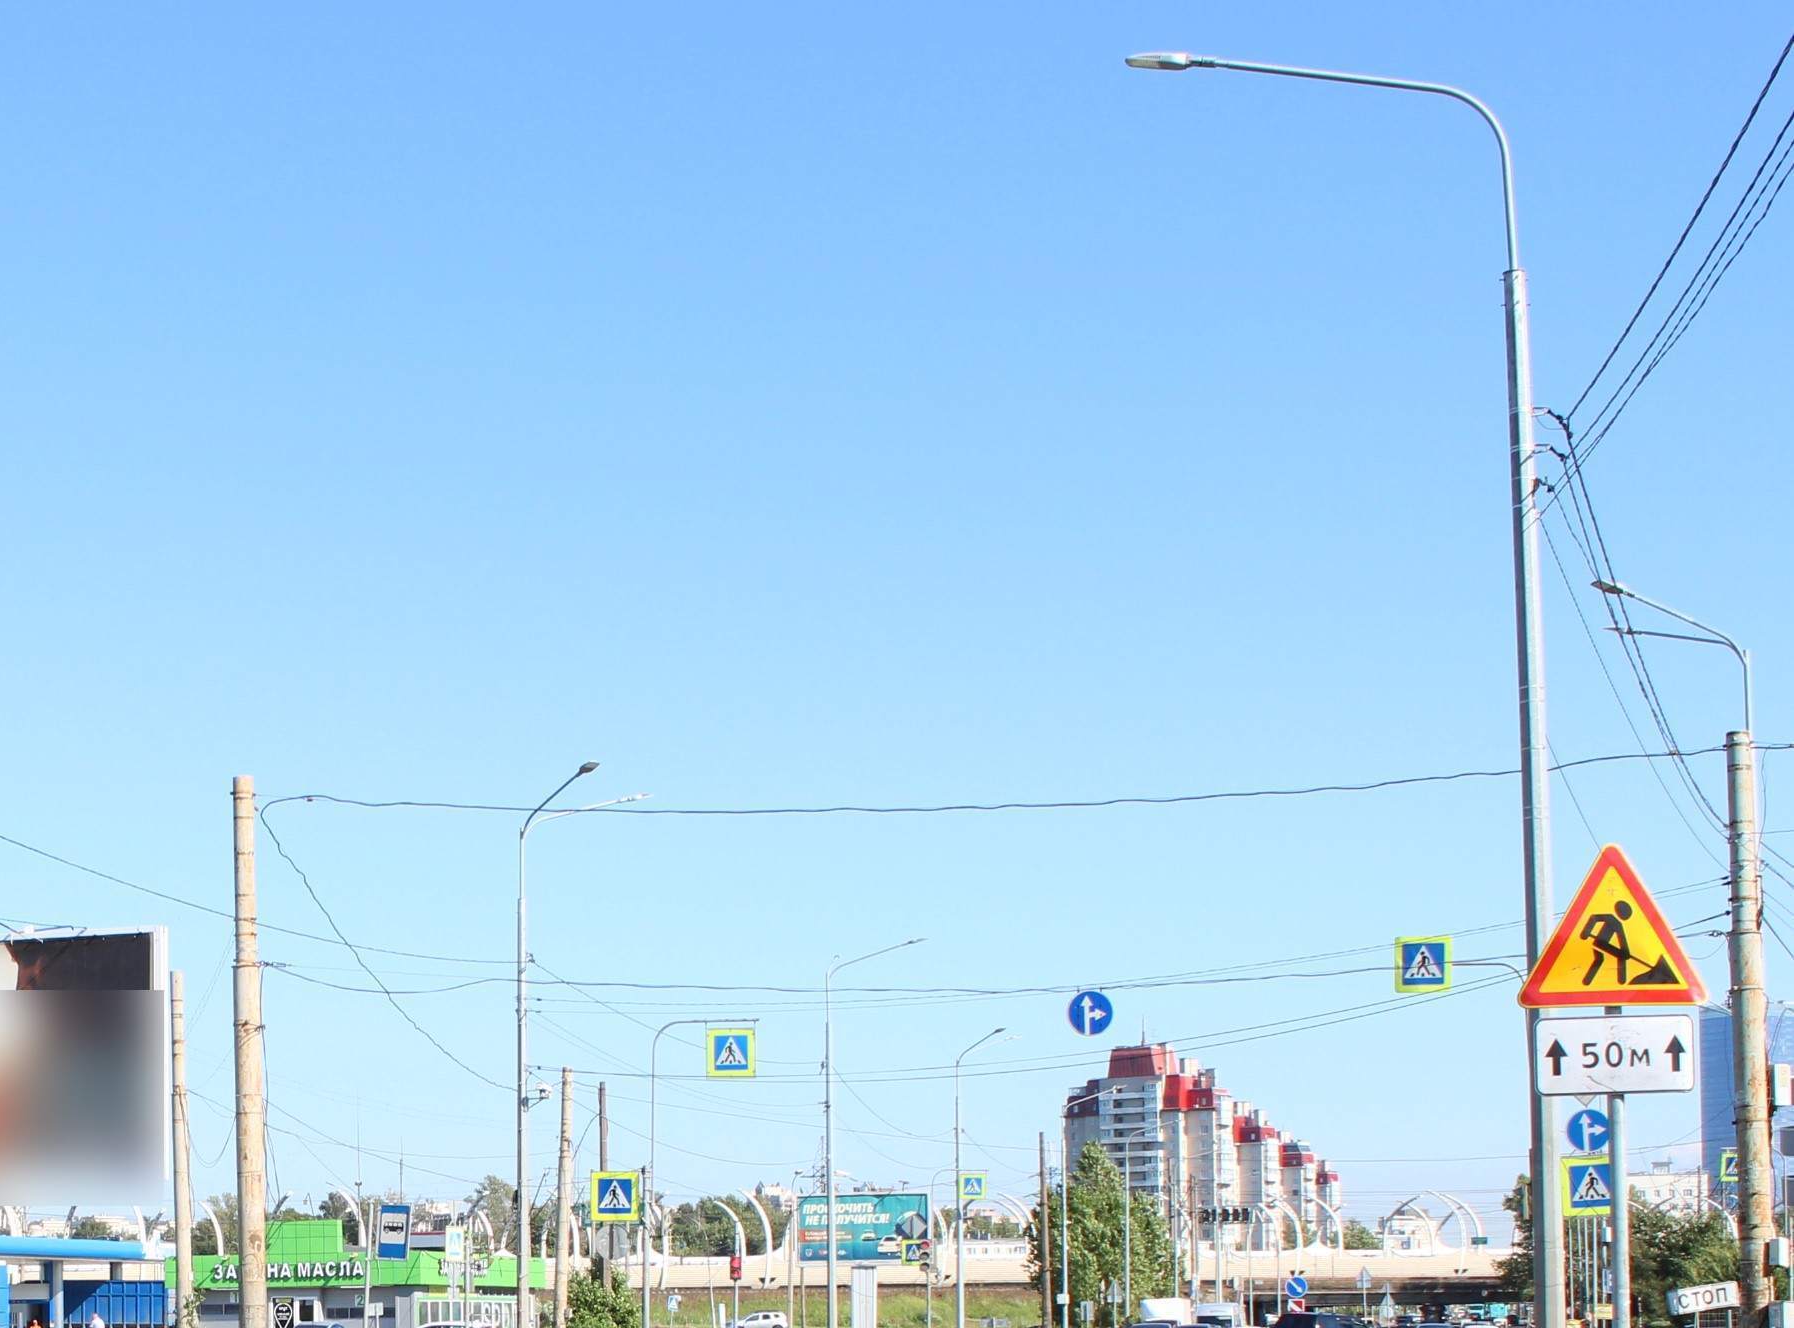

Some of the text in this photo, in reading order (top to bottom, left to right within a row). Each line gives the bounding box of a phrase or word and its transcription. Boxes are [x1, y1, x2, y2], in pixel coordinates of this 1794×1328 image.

[803, 1203, 874, 1214] ПРООЧИТЬ
[805, 1213, 890, 1225] НЕ ПЛУЧИТСЯ!
[214, 1262, 364, 1279] ЗАНА МАСЛА
[356, 1294, 365, 1306] 2
[1678, 1287, 1728, 1309] СТОП
